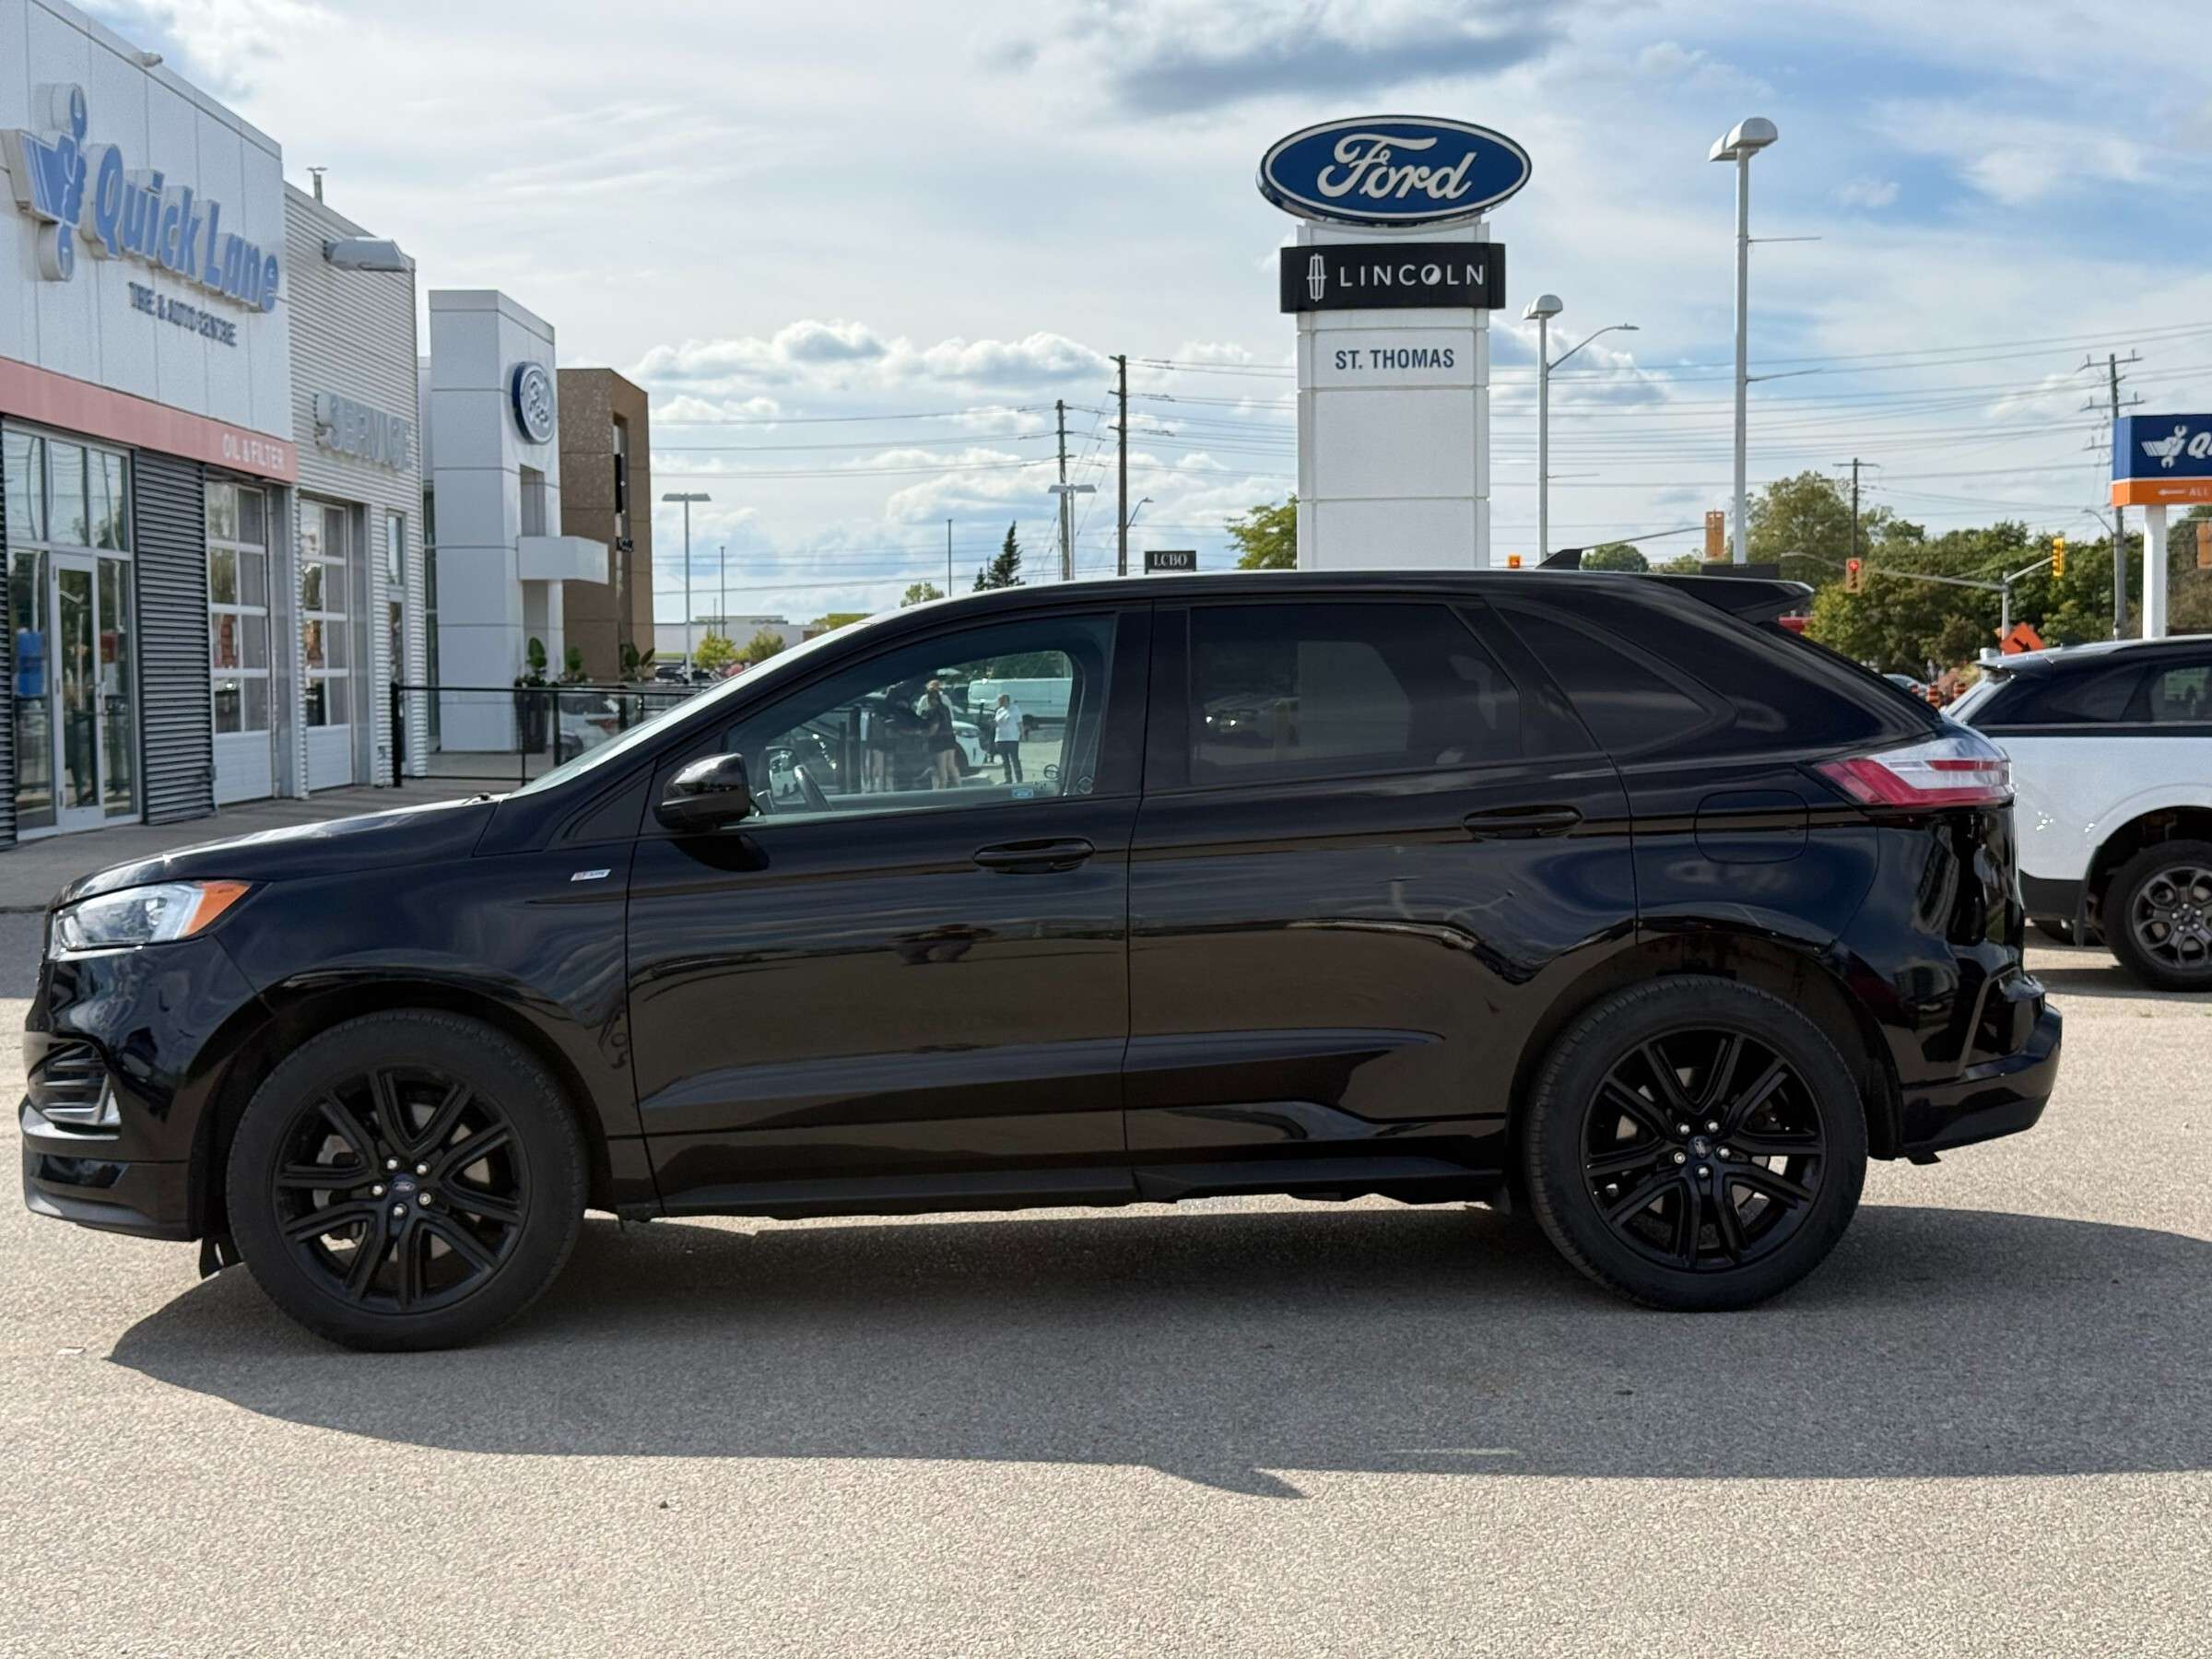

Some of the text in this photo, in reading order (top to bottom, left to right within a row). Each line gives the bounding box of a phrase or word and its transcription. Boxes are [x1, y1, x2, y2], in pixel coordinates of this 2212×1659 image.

[1317, 133, 1477, 200] Ford
[96, 144, 278, 314] Quick Lane
[1339, 263, 1485, 288] LINCOLN
[1335, 348, 1454, 370] ST. THOMAS
[1153, 553, 1188, 567] LCBO
